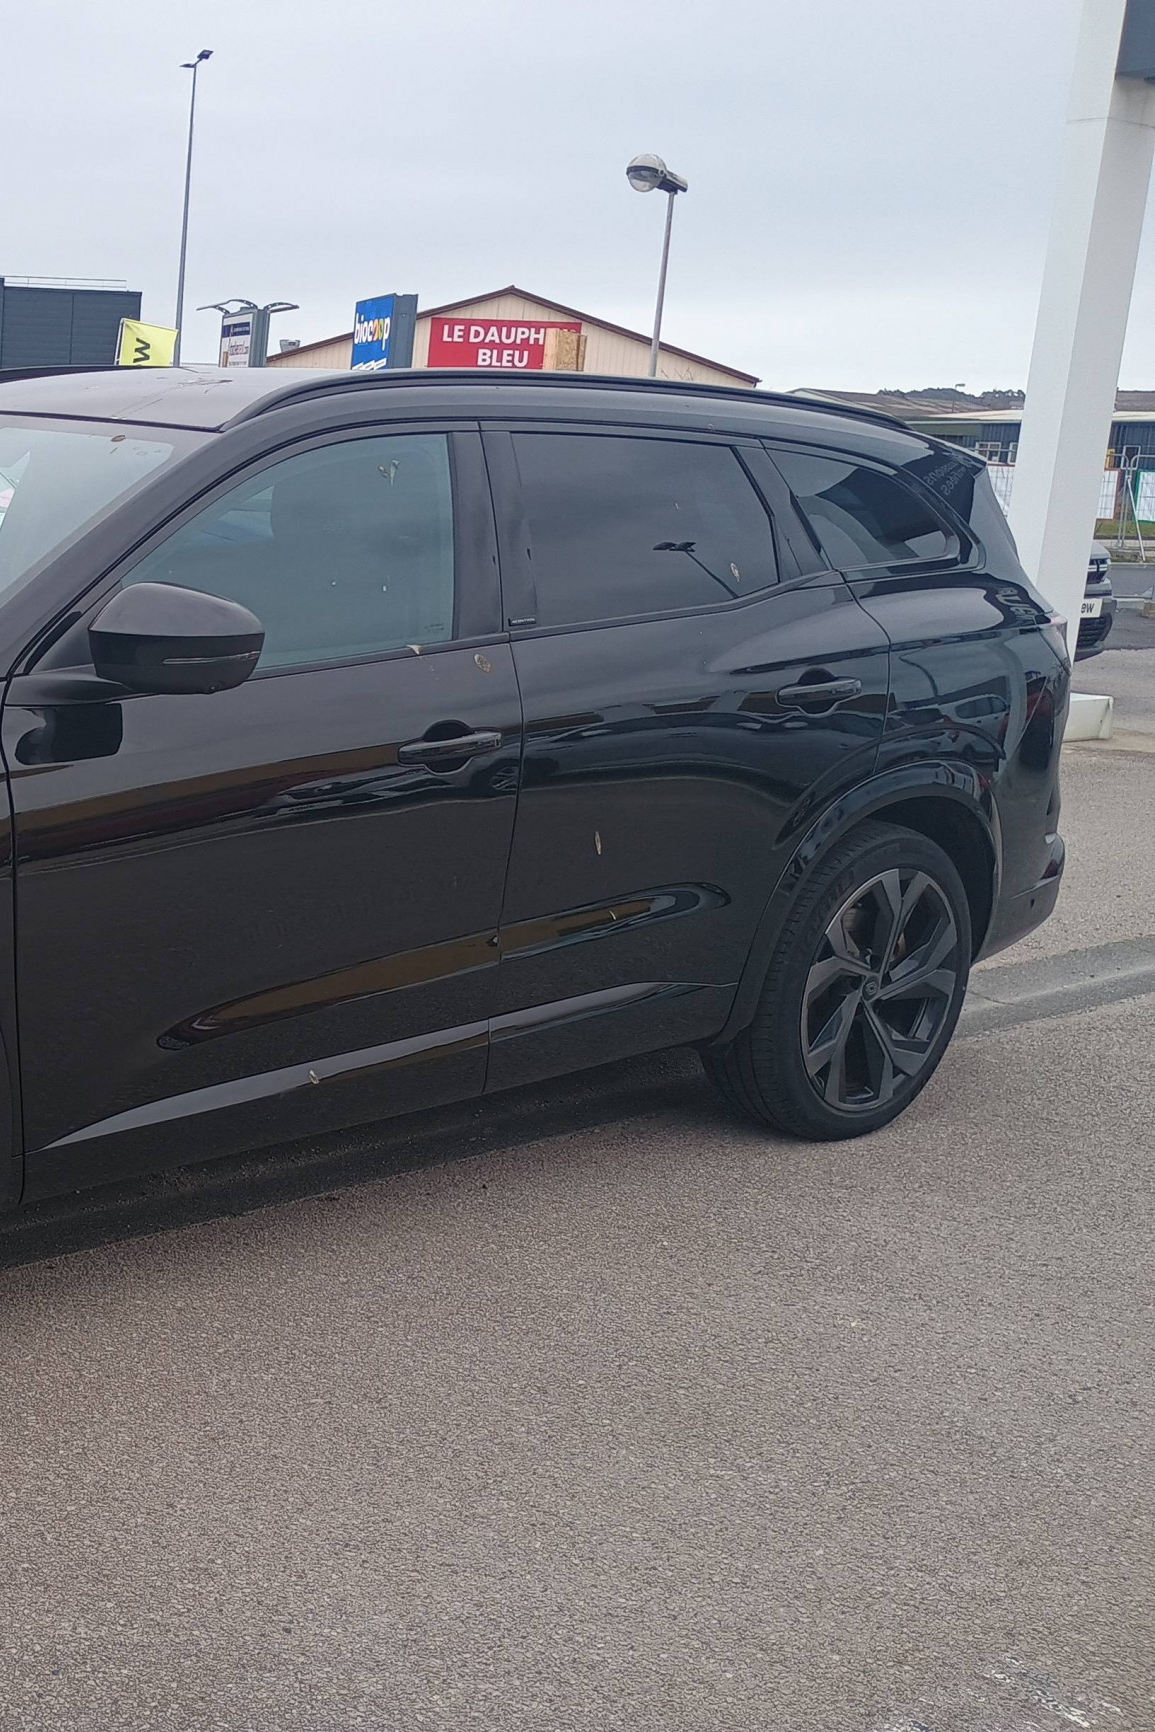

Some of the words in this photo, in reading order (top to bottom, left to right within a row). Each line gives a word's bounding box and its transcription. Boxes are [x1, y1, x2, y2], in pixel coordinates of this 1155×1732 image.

[354, 312, 391, 351] biocoop
[442, 324, 465, 342] LE
[468, 325, 546, 345] DAUPH
[477, 348, 529, 368] BLEU
[1081, 603, 1095, 614] ew
